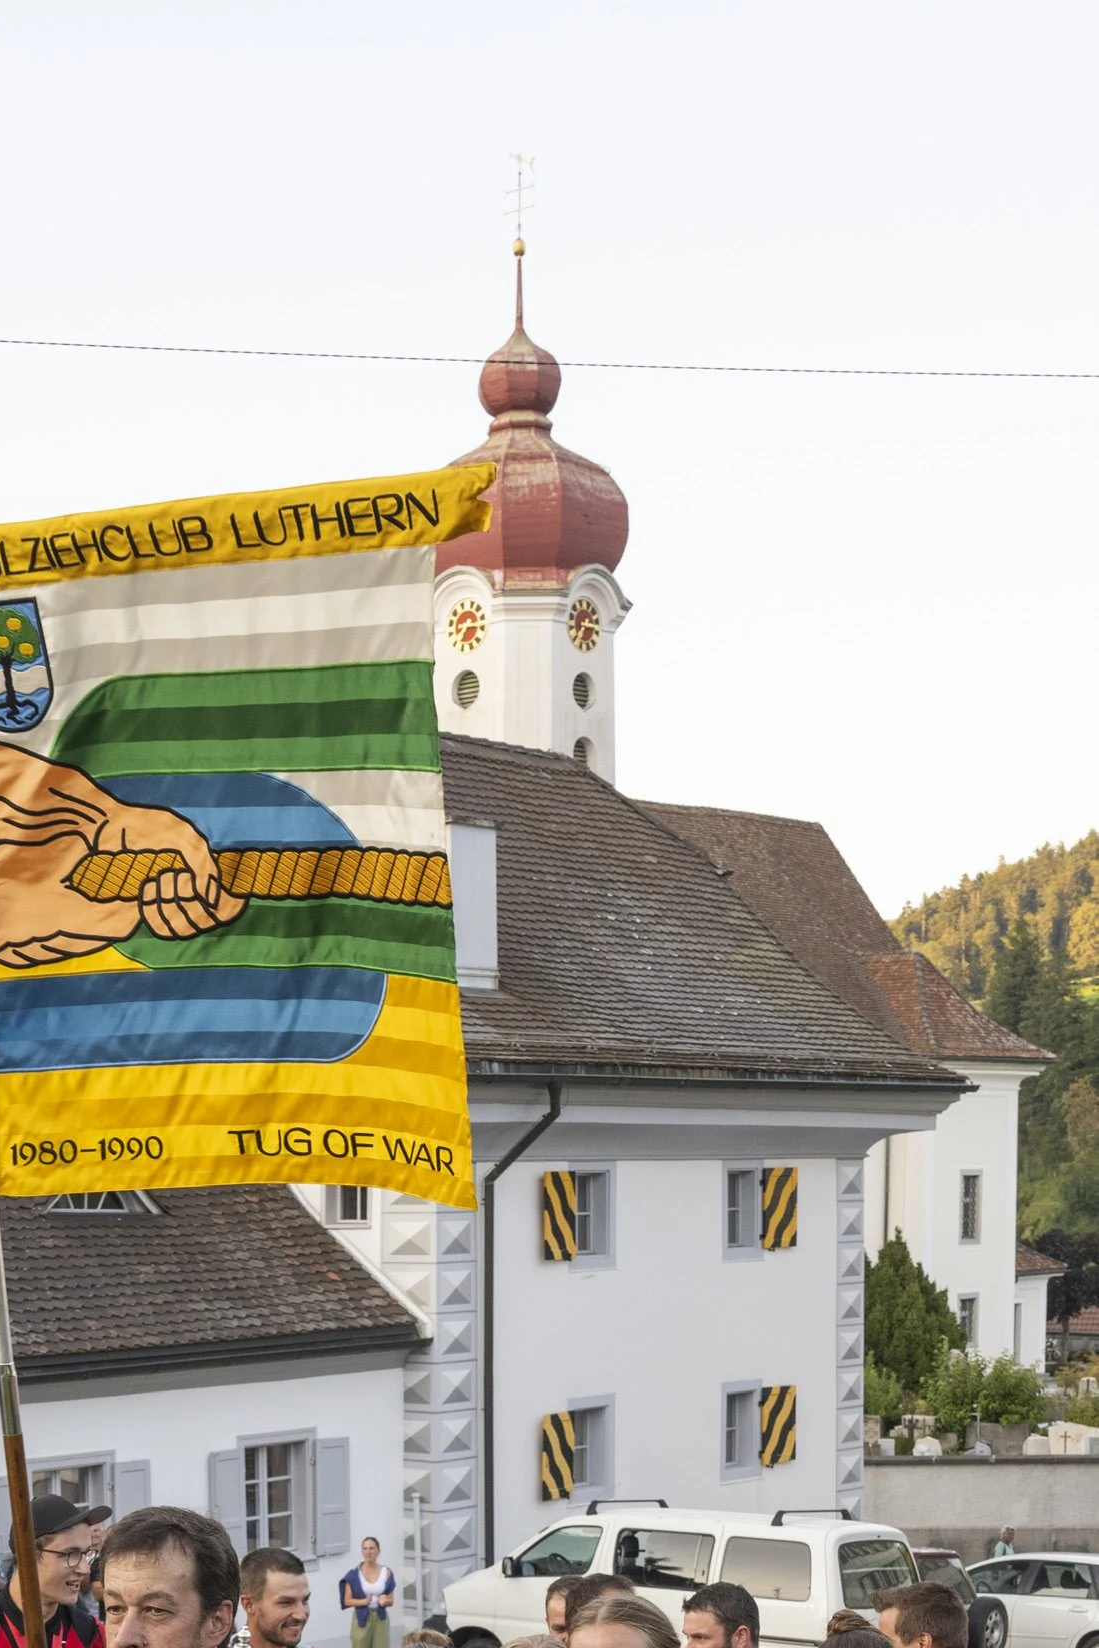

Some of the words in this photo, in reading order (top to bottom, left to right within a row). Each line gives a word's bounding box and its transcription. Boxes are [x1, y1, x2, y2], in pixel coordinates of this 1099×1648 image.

[229, 488, 440, 549] LUTHERN
[10, 1135, 164, 1167] 1980-1990
[227, 1128, 312, 1157] TUG
[322, 1129, 374, 1158] OF
[382, 1134, 455, 1176] WAR
